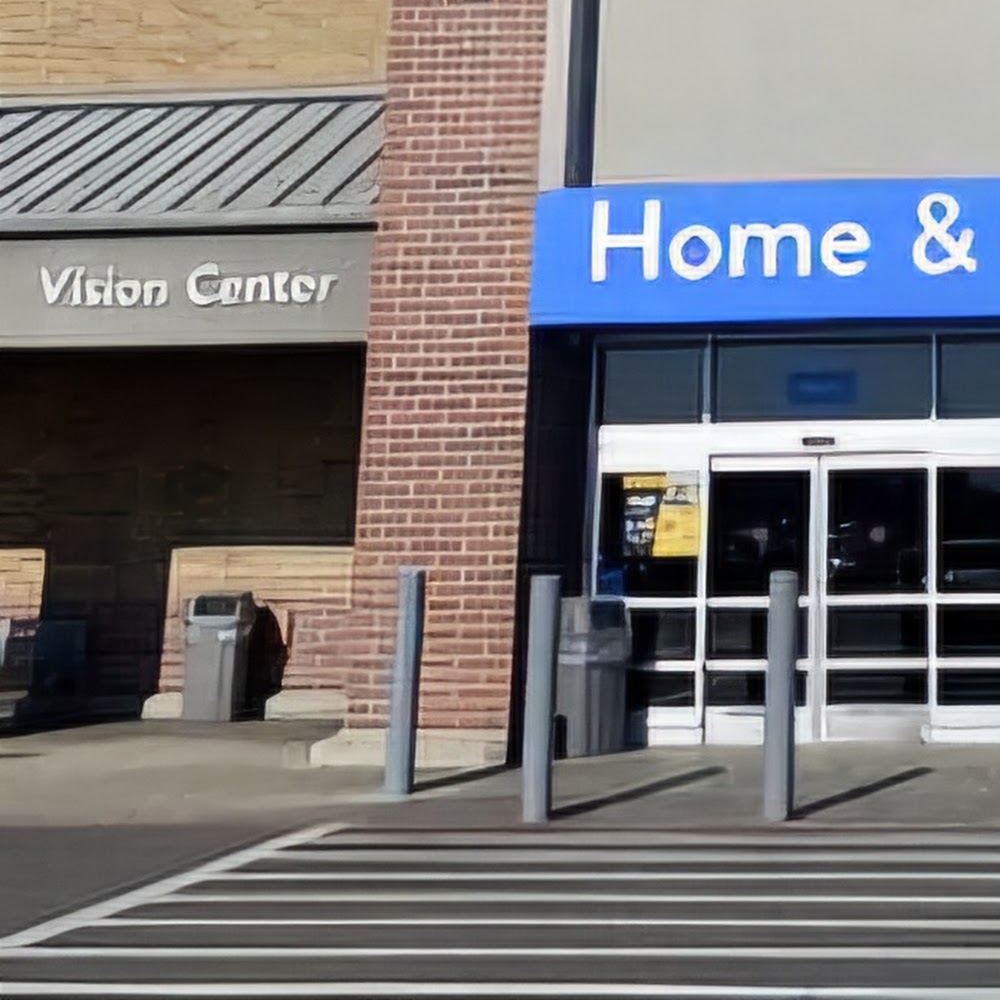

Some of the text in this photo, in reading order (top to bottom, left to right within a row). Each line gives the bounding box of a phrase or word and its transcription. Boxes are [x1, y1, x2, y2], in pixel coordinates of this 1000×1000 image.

[590, 198, 872, 283] Home
[912, 192, 979, 276] &
[40, 264, 169, 307] Vision
